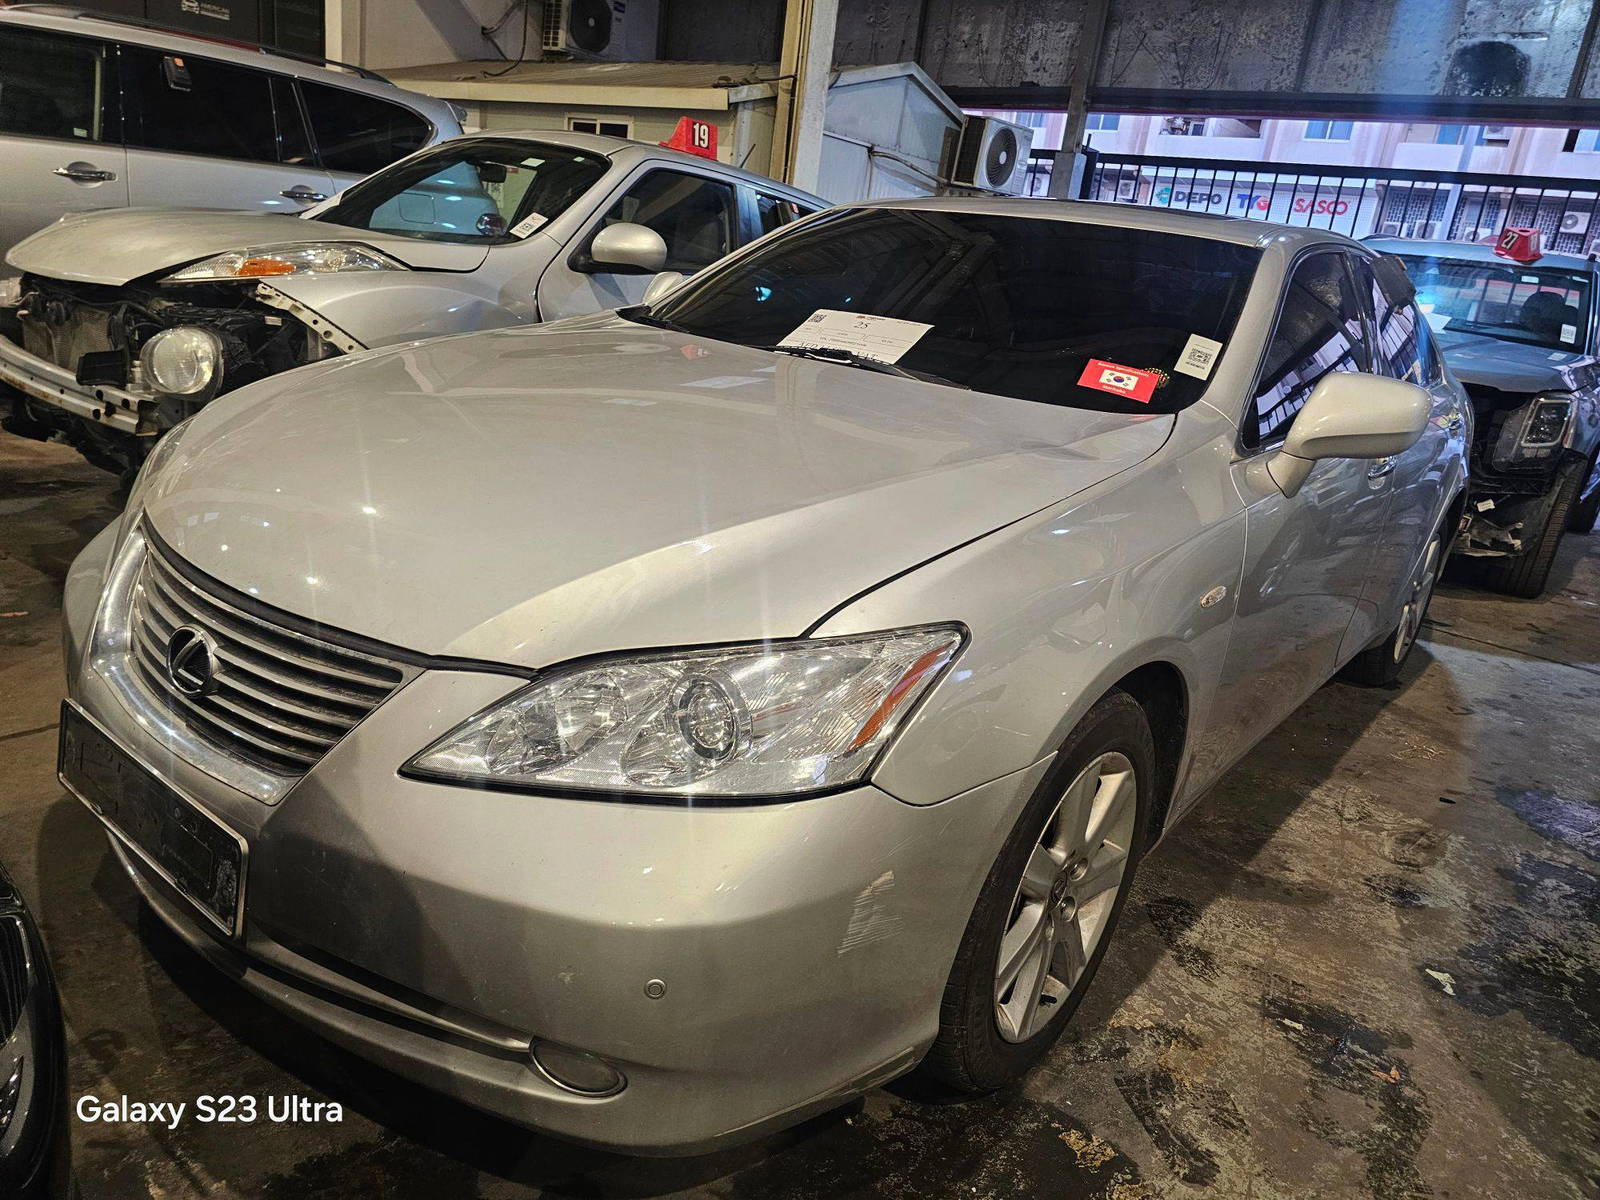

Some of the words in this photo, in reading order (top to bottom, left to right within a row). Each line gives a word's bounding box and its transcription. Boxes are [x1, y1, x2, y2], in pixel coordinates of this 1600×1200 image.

[693, 122, 709, 148] 19
[1174, 190, 1222, 205] DEPO
[1294, 198, 1348, 216] SASCO
[1501, 231, 1519, 250] 27
[853, 320, 871, 330] 25
